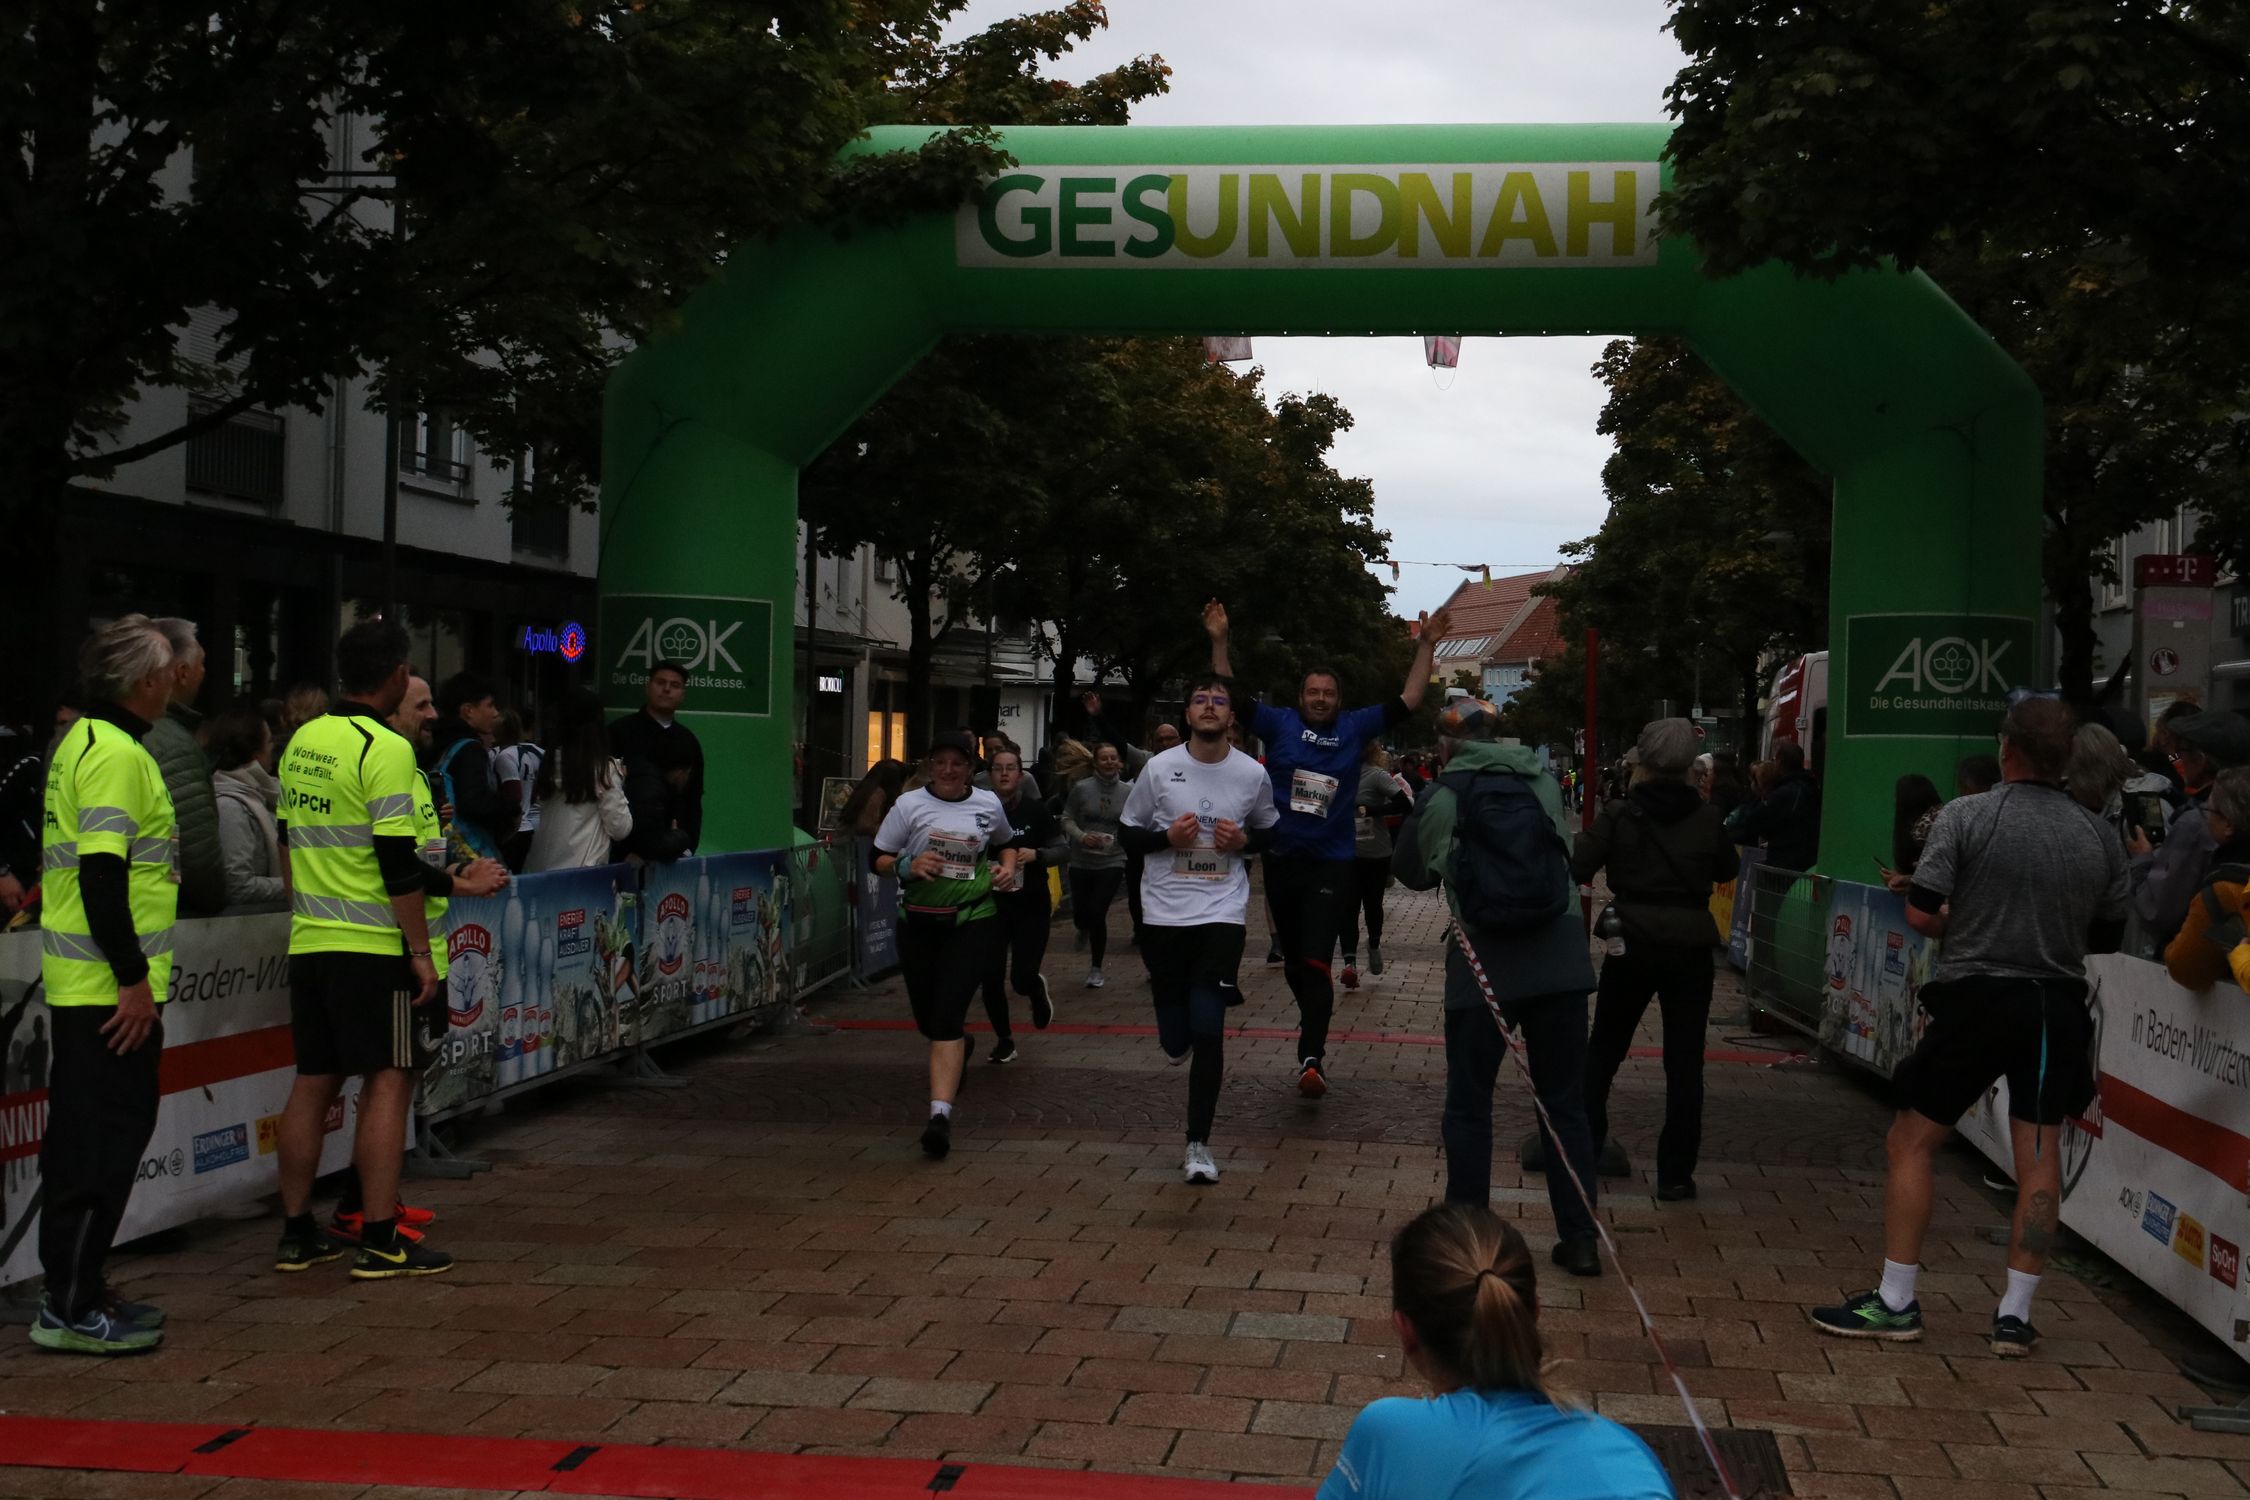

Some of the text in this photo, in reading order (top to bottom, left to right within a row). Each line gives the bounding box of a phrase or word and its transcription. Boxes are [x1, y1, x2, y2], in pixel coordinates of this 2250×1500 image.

[977, 171, 1637, 258] GESUNDNAH
[523, 625, 558, 656] Apollo
[615, 617, 744, 673] AOK
[1873, 636, 2012, 694] AOK
[612, 672, 746, 689] Die Geseitskasse.
[1870, 696, 1889, 710] Die
[292, 745, 339, 768] Workwear,
[288, 760, 334, 782] die auffällt.
[299, 789, 331, 815] PCH
[1295, 786, 1329, 802] Markus
[1188, 860, 1217, 872] Leon
[660, 897, 686, 917] APOLLO
[449, 927, 486, 958] APOLLO
[654, 980, 688, 1005] SPORT
[2131, 1002, 2143, 1045] in
[194, 1128, 237, 1155] ERDINGER
[136, 1155, 168, 1183] AOK
